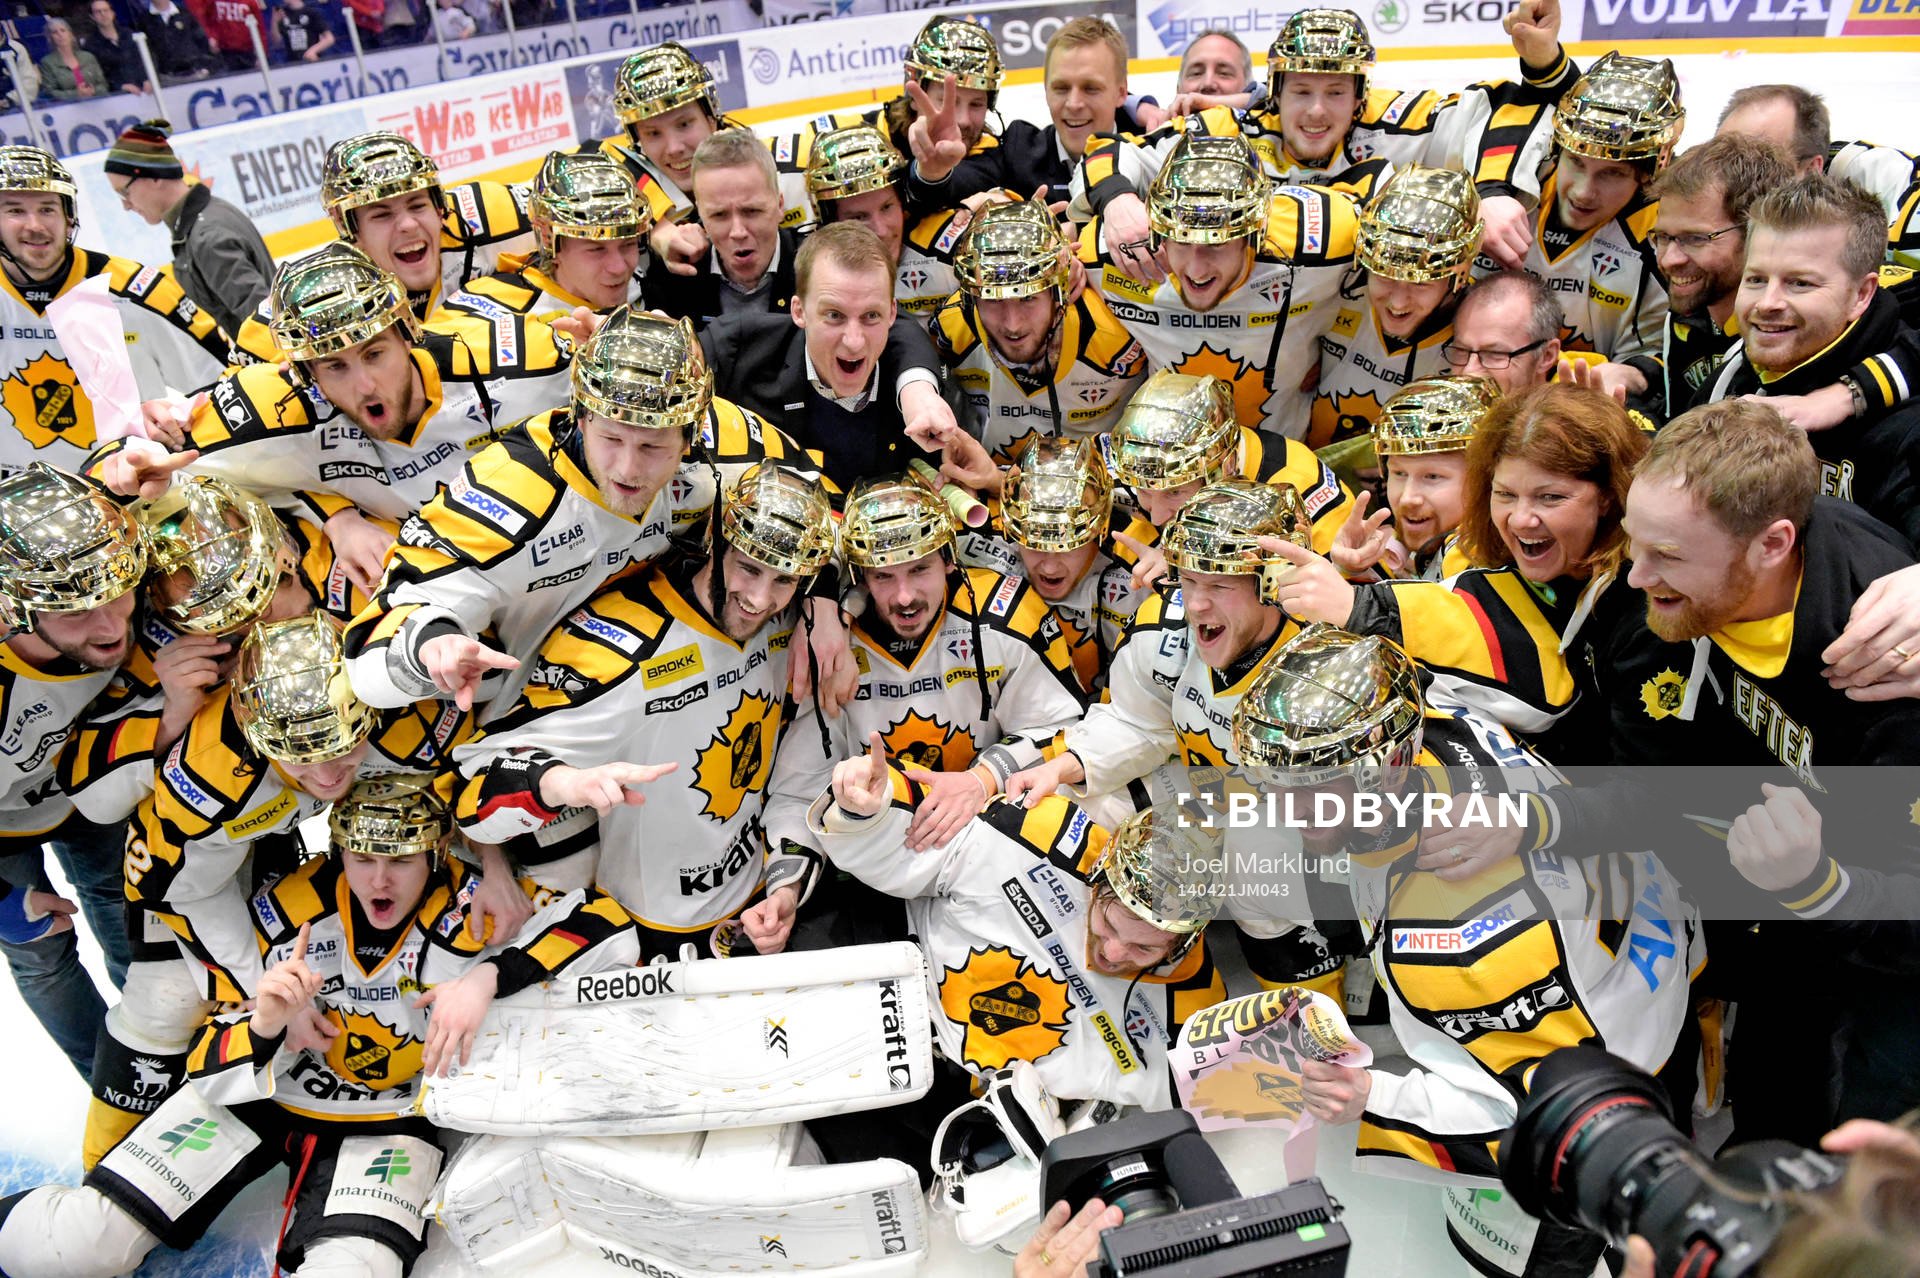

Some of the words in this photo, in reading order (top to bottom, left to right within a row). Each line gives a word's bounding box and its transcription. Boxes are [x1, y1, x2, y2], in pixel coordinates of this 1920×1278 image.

[1423, 0, 1521, 23] SKO
[787, 39, 911, 78] Anticime
[400, 100, 476, 155] EWAB
[1543, 230, 1571, 246] SHL
[1170, 313, 1241, 329] BOLIDEN
[1250, 304, 1310, 325] engon
[14, 327, 57, 340] BOLID
[1015, 373, 1042, 388] SHL
[1353, 352, 1406, 386] BOLIDE
[1001, 405, 1052, 419] BOLIDE
[340, 426, 374, 441] LEA
[394, 440, 462, 482] BOLIDEN
[323, 465, 387, 485] ŠKODA
[550, 523, 585, 549] LEAB
[997, 574, 1019, 602] INTER
[889, 639, 918, 653] SHL
[646, 653, 697, 680] BROKK
[649, 686, 707, 712] ŠKODA
[878, 676, 943, 698] BOLIDEN
[1186, 686, 1232, 731] BOLIDE
[1734, 672, 1828, 793] EFTER
[164, 739, 209, 807] TERSPORT
[499, 757, 530, 773] Reebok
[990, 753, 1013, 777] Reebo
[231, 798, 292, 834] BROKK
[679, 813, 764, 897] kraft
[1047, 876, 1076, 914] LEAB
[1005, 883, 1046, 936] ŠKODA
[1407, 902, 1517, 951] INTERSPORT
[357, 945, 388, 958] SHL
[577, 967, 676, 1004] Reebok
[1048, 944, 1099, 1010] BOLIDEN
[346, 985, 399, 1002] OLIDEN
[879, 979, 910, 1062] kraft
[982, 1015, 1000, 1034] 1921
[1095, 1014, 1131, 1070] engcon
[122, 1140, 197, 1203] martinsons
[871, 1189, 901, 1237] kraft
